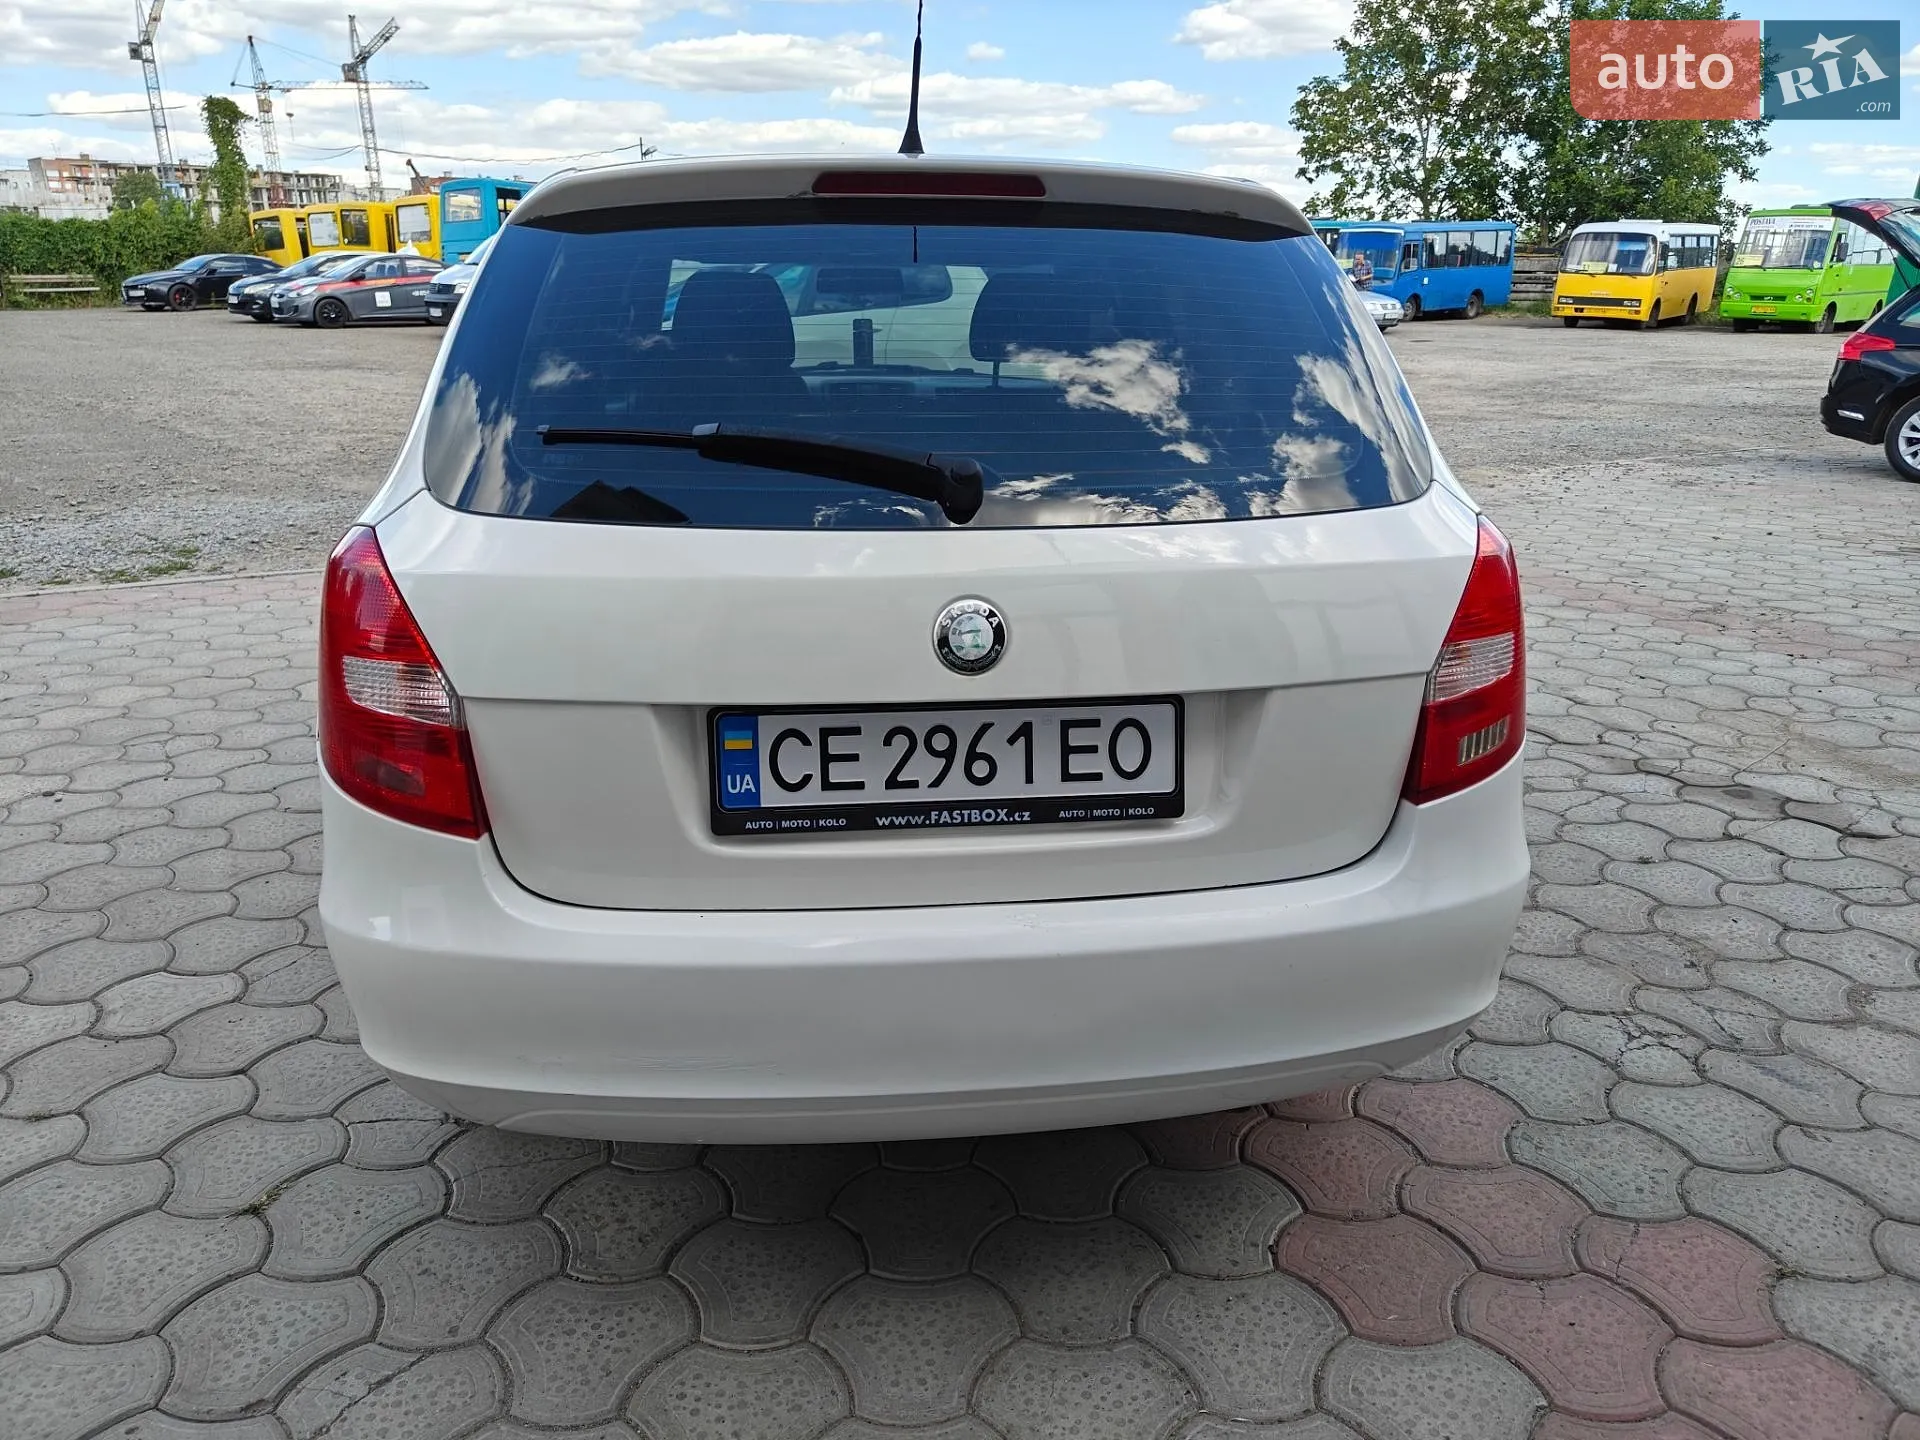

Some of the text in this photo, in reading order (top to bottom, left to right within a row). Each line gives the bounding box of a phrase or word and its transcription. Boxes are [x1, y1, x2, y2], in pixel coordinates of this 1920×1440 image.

[768, 717, 1153, 793] CE 2961 EO
[726, 773, 757, 794] UA
[875, 808, 1031, 827] www.FASTBOX.cz
[1058, 807, 1155, 818] AUTO MOTO KOLO
[745, 818, 847, 830] AUTO MOTO KOLO
